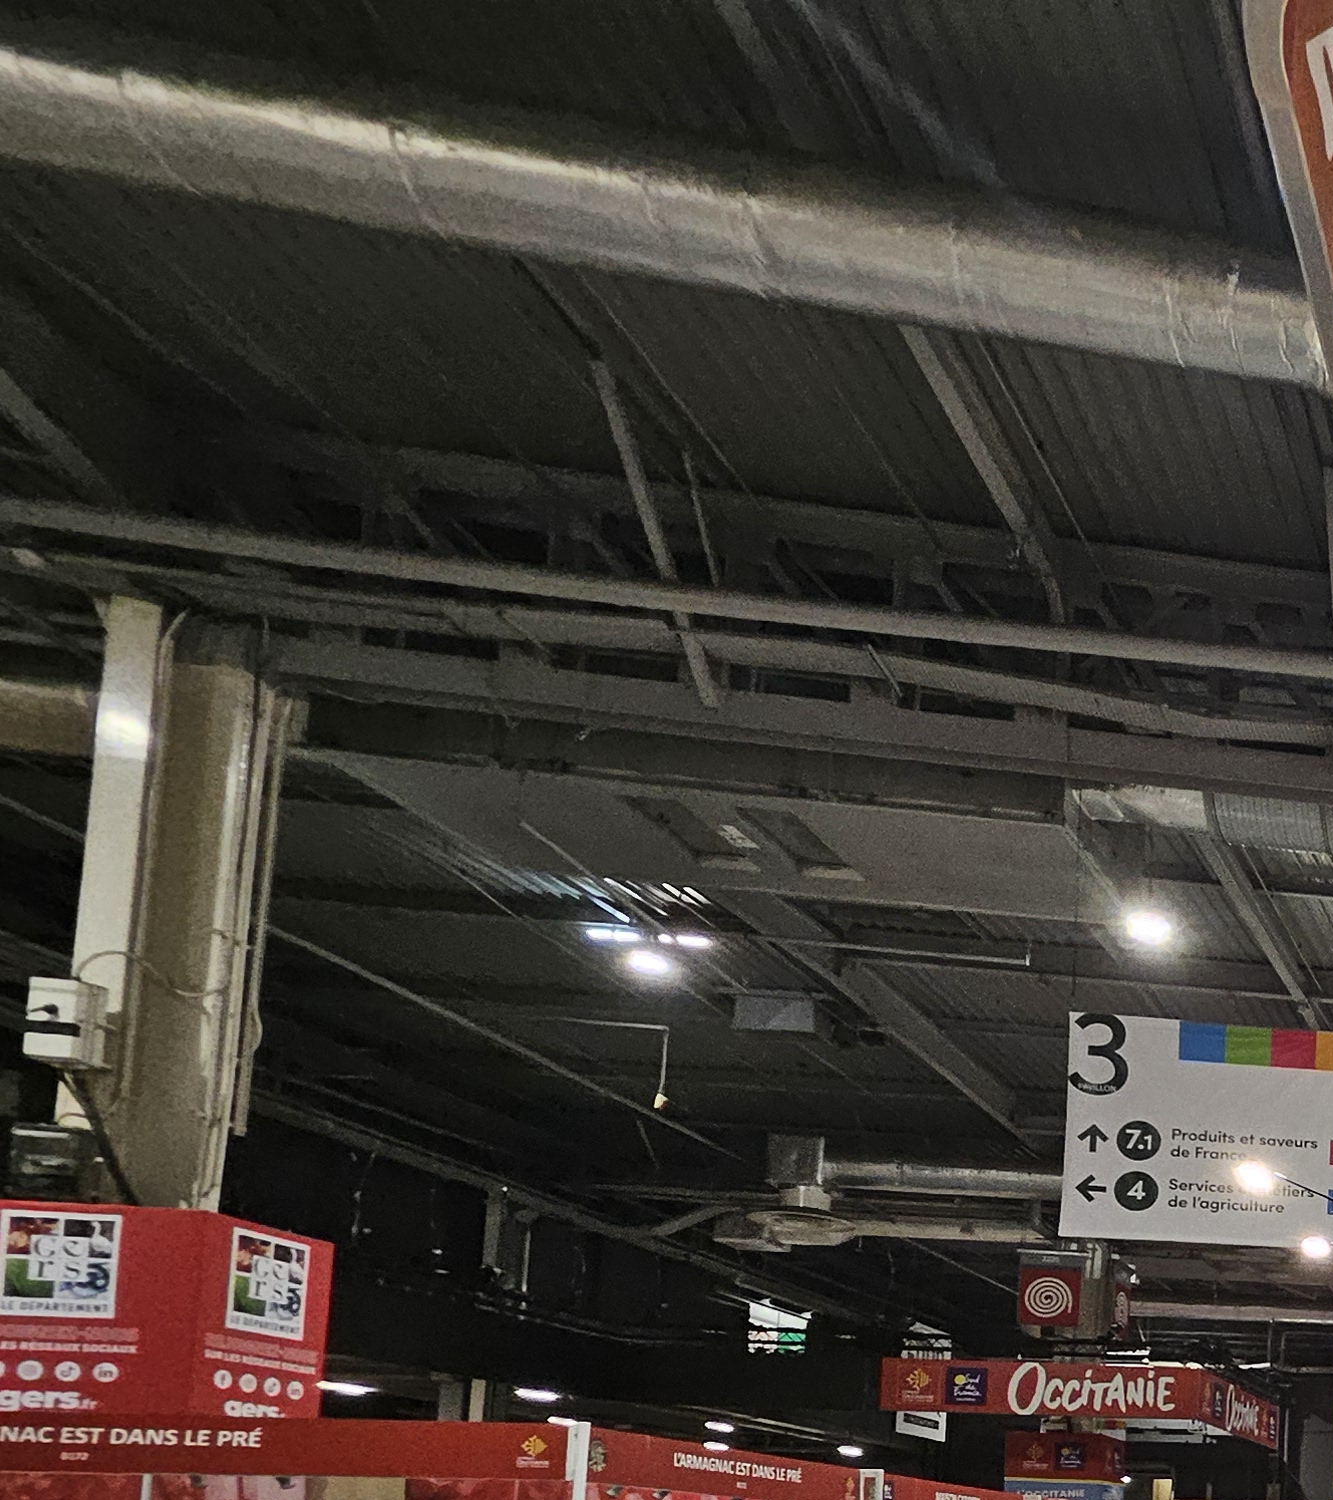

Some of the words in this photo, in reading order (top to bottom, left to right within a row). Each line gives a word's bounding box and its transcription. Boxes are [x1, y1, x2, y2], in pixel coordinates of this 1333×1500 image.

[1068, 1012, 1129, 1096] 3
[1077, 1081, 1118, 1093] PAVILLON
[1124, 1128, 1153, 1151] 7.1
[1170, 1128, 1236, 1145] Produits
[1239, 1135, 1256, 1147] et
[1259, 1138, 1319, 1150] saveurs
[1170, 1147, 1192, 1159] de
[1126, 1180, 1147, 1201] 4
[1168, 1178, 1234, 1194] Services
[1168, 1195, 1190, 1209] de
[1192, 1197, 1286, 1214] l'agriculture
[18, 1301, 110, 1313] DÉPARTEMENT
[1008, 1362, 1175, 1416] OCCITANIE
[59, 1427, 105, 1445] EST
[109, 1428, 179, 1447] DANS
[183, 1429, 213, 1447] LE
[216, 1426, 263, 1448] PRÉ
[673, 1451, 734, 1476] L'ARMAGNAC
[735, 1461, 750, 1478] EST
[751, 1463, 775, 1480] DANS
[776, 1465, 786, 1481] LE
[786, 1467, 802, 1483] PRÉ
